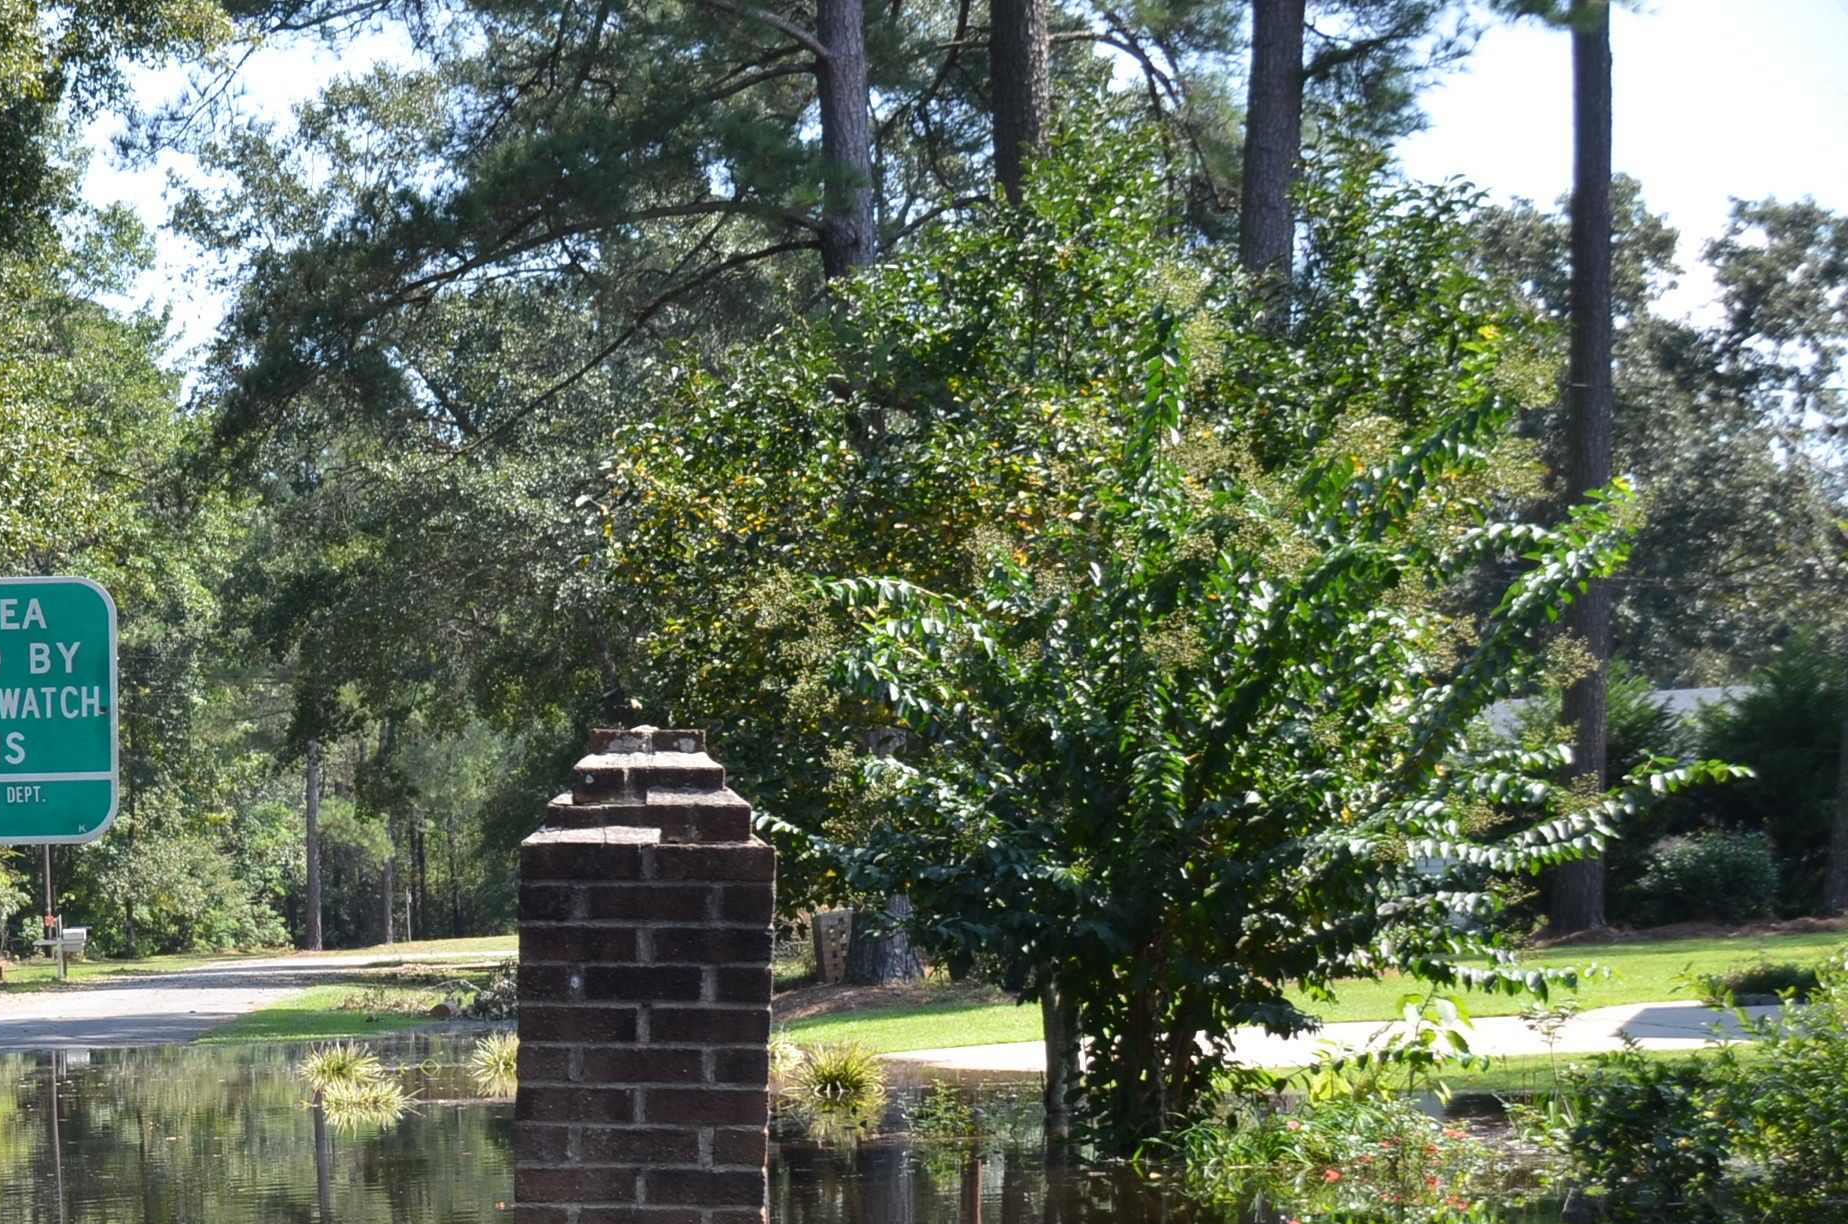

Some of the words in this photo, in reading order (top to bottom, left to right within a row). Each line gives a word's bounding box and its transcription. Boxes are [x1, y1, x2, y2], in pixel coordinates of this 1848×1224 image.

[29, 641, 81, 675] BY
[7, 785, 46, 804] DEPT.
[78, 824, 87, 833] K
